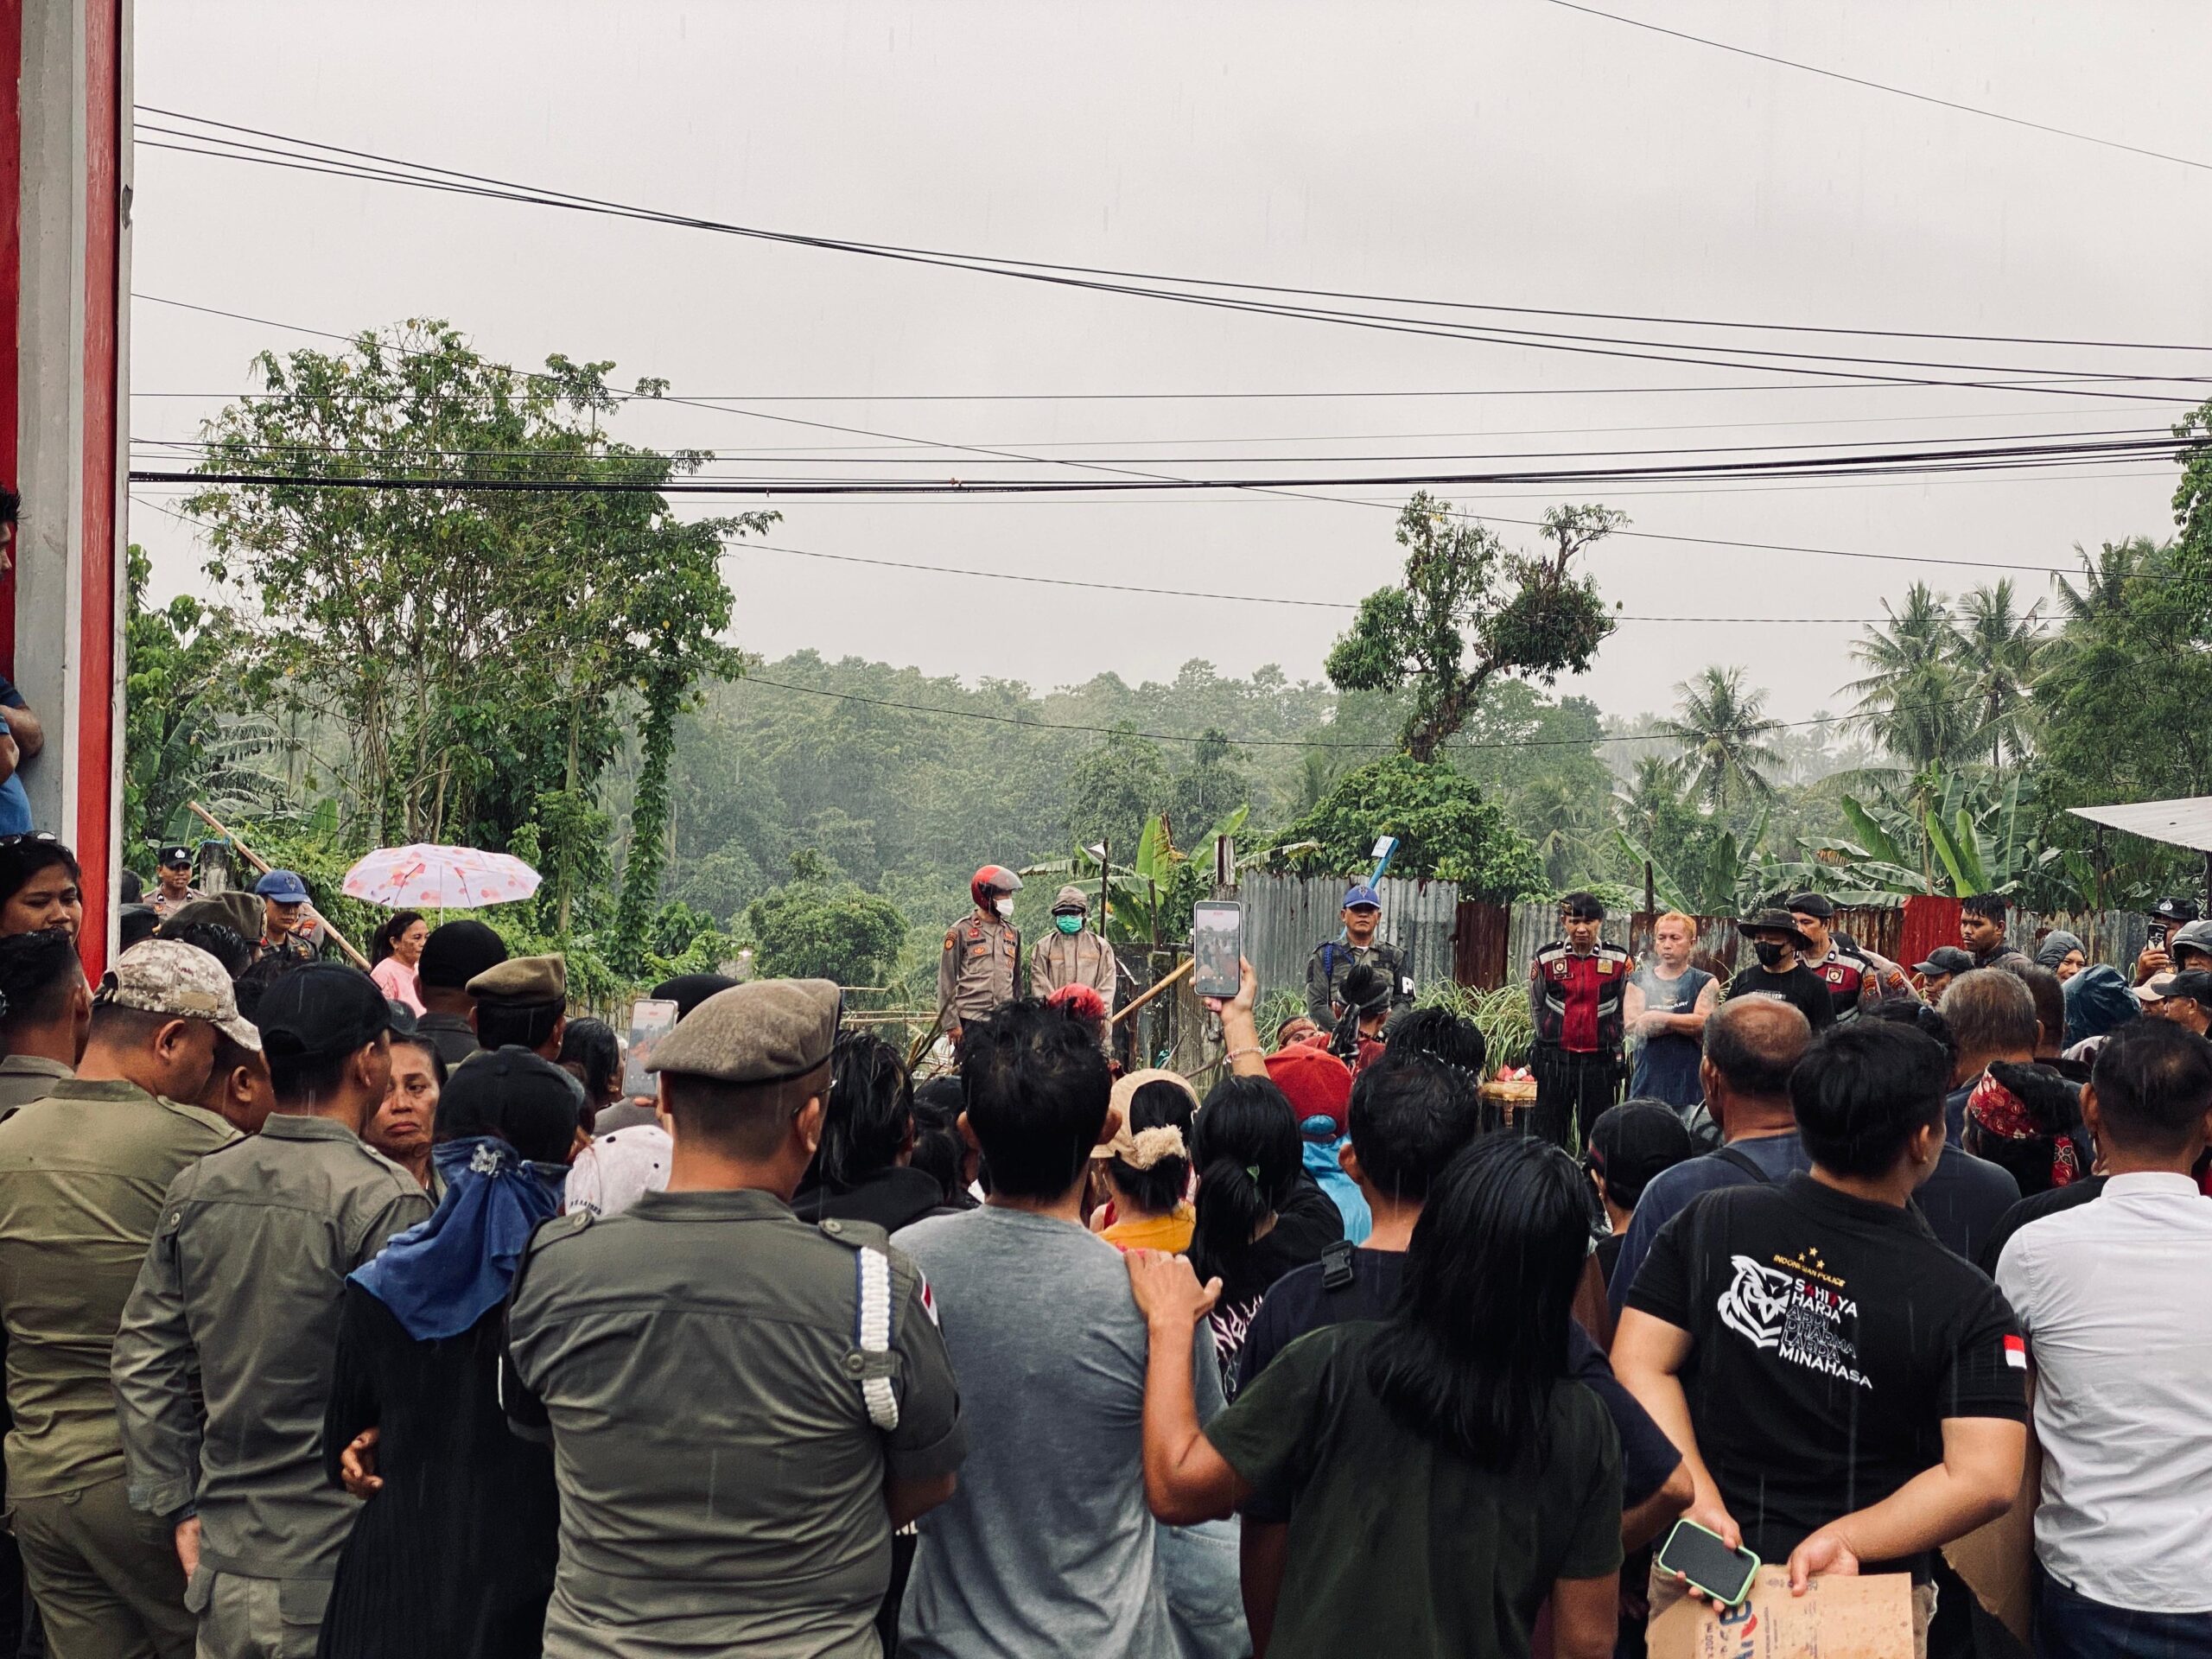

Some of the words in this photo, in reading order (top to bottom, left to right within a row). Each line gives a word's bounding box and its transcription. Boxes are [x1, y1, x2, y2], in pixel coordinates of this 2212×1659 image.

[1786, 1305, 1830, 1332] ABDI
[1791, 1291, 1841, 1325] HARJA
[1781, 1329, 1840, 1364] LABDA
[1784, 1318, 1857, 1359] DHARMA
[1778, 1343, 1873, 1389] MINAHASA
